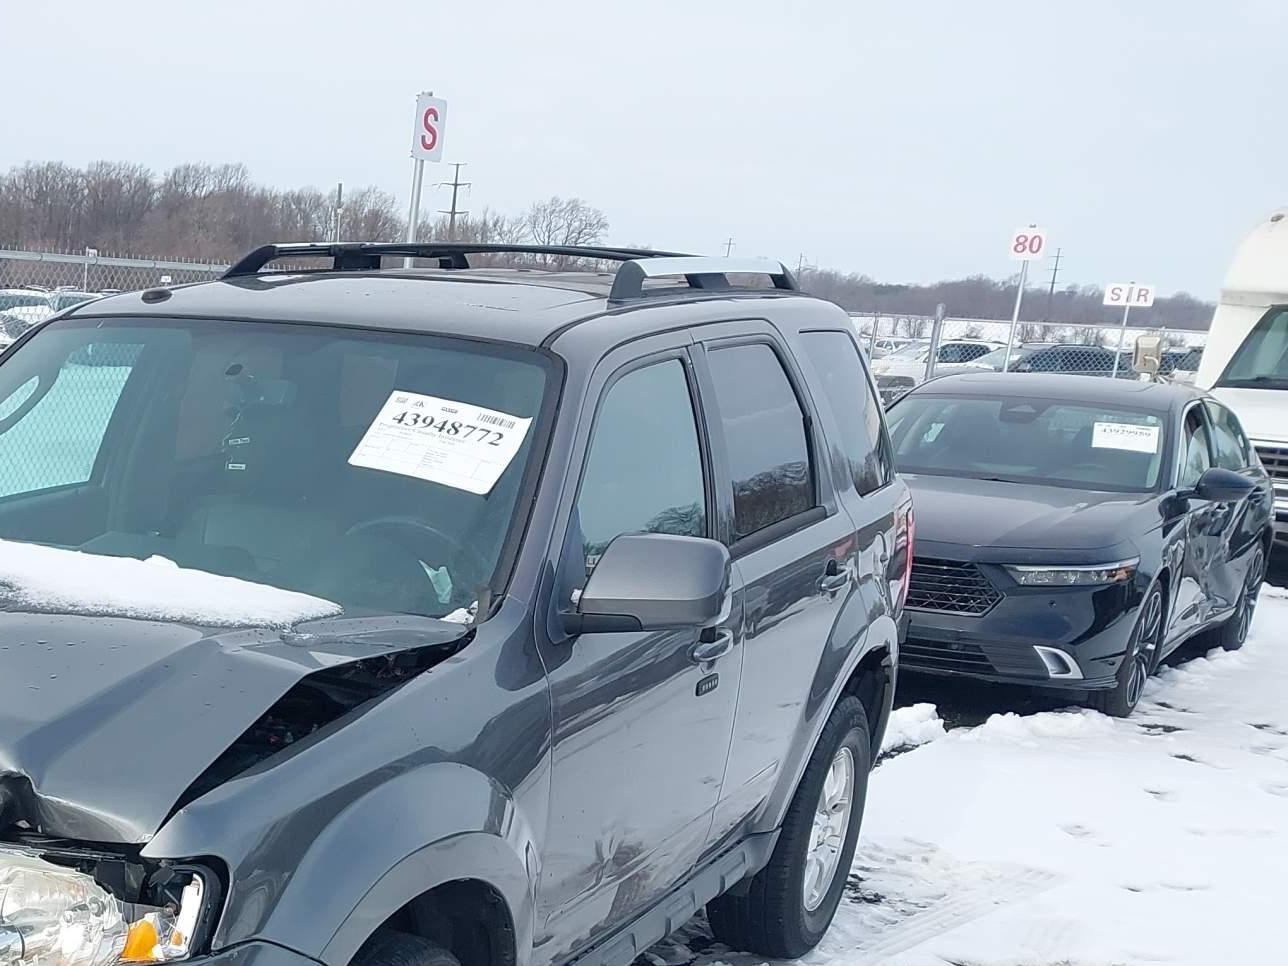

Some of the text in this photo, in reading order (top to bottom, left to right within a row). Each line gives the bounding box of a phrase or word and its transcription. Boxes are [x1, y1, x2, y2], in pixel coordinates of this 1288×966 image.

[421, 107, 439, 150] S
[1013, 235, 1043, 254] 80
[1110, 287, 1149, 302] S R
[392, 411, 504, 446] 43948772
